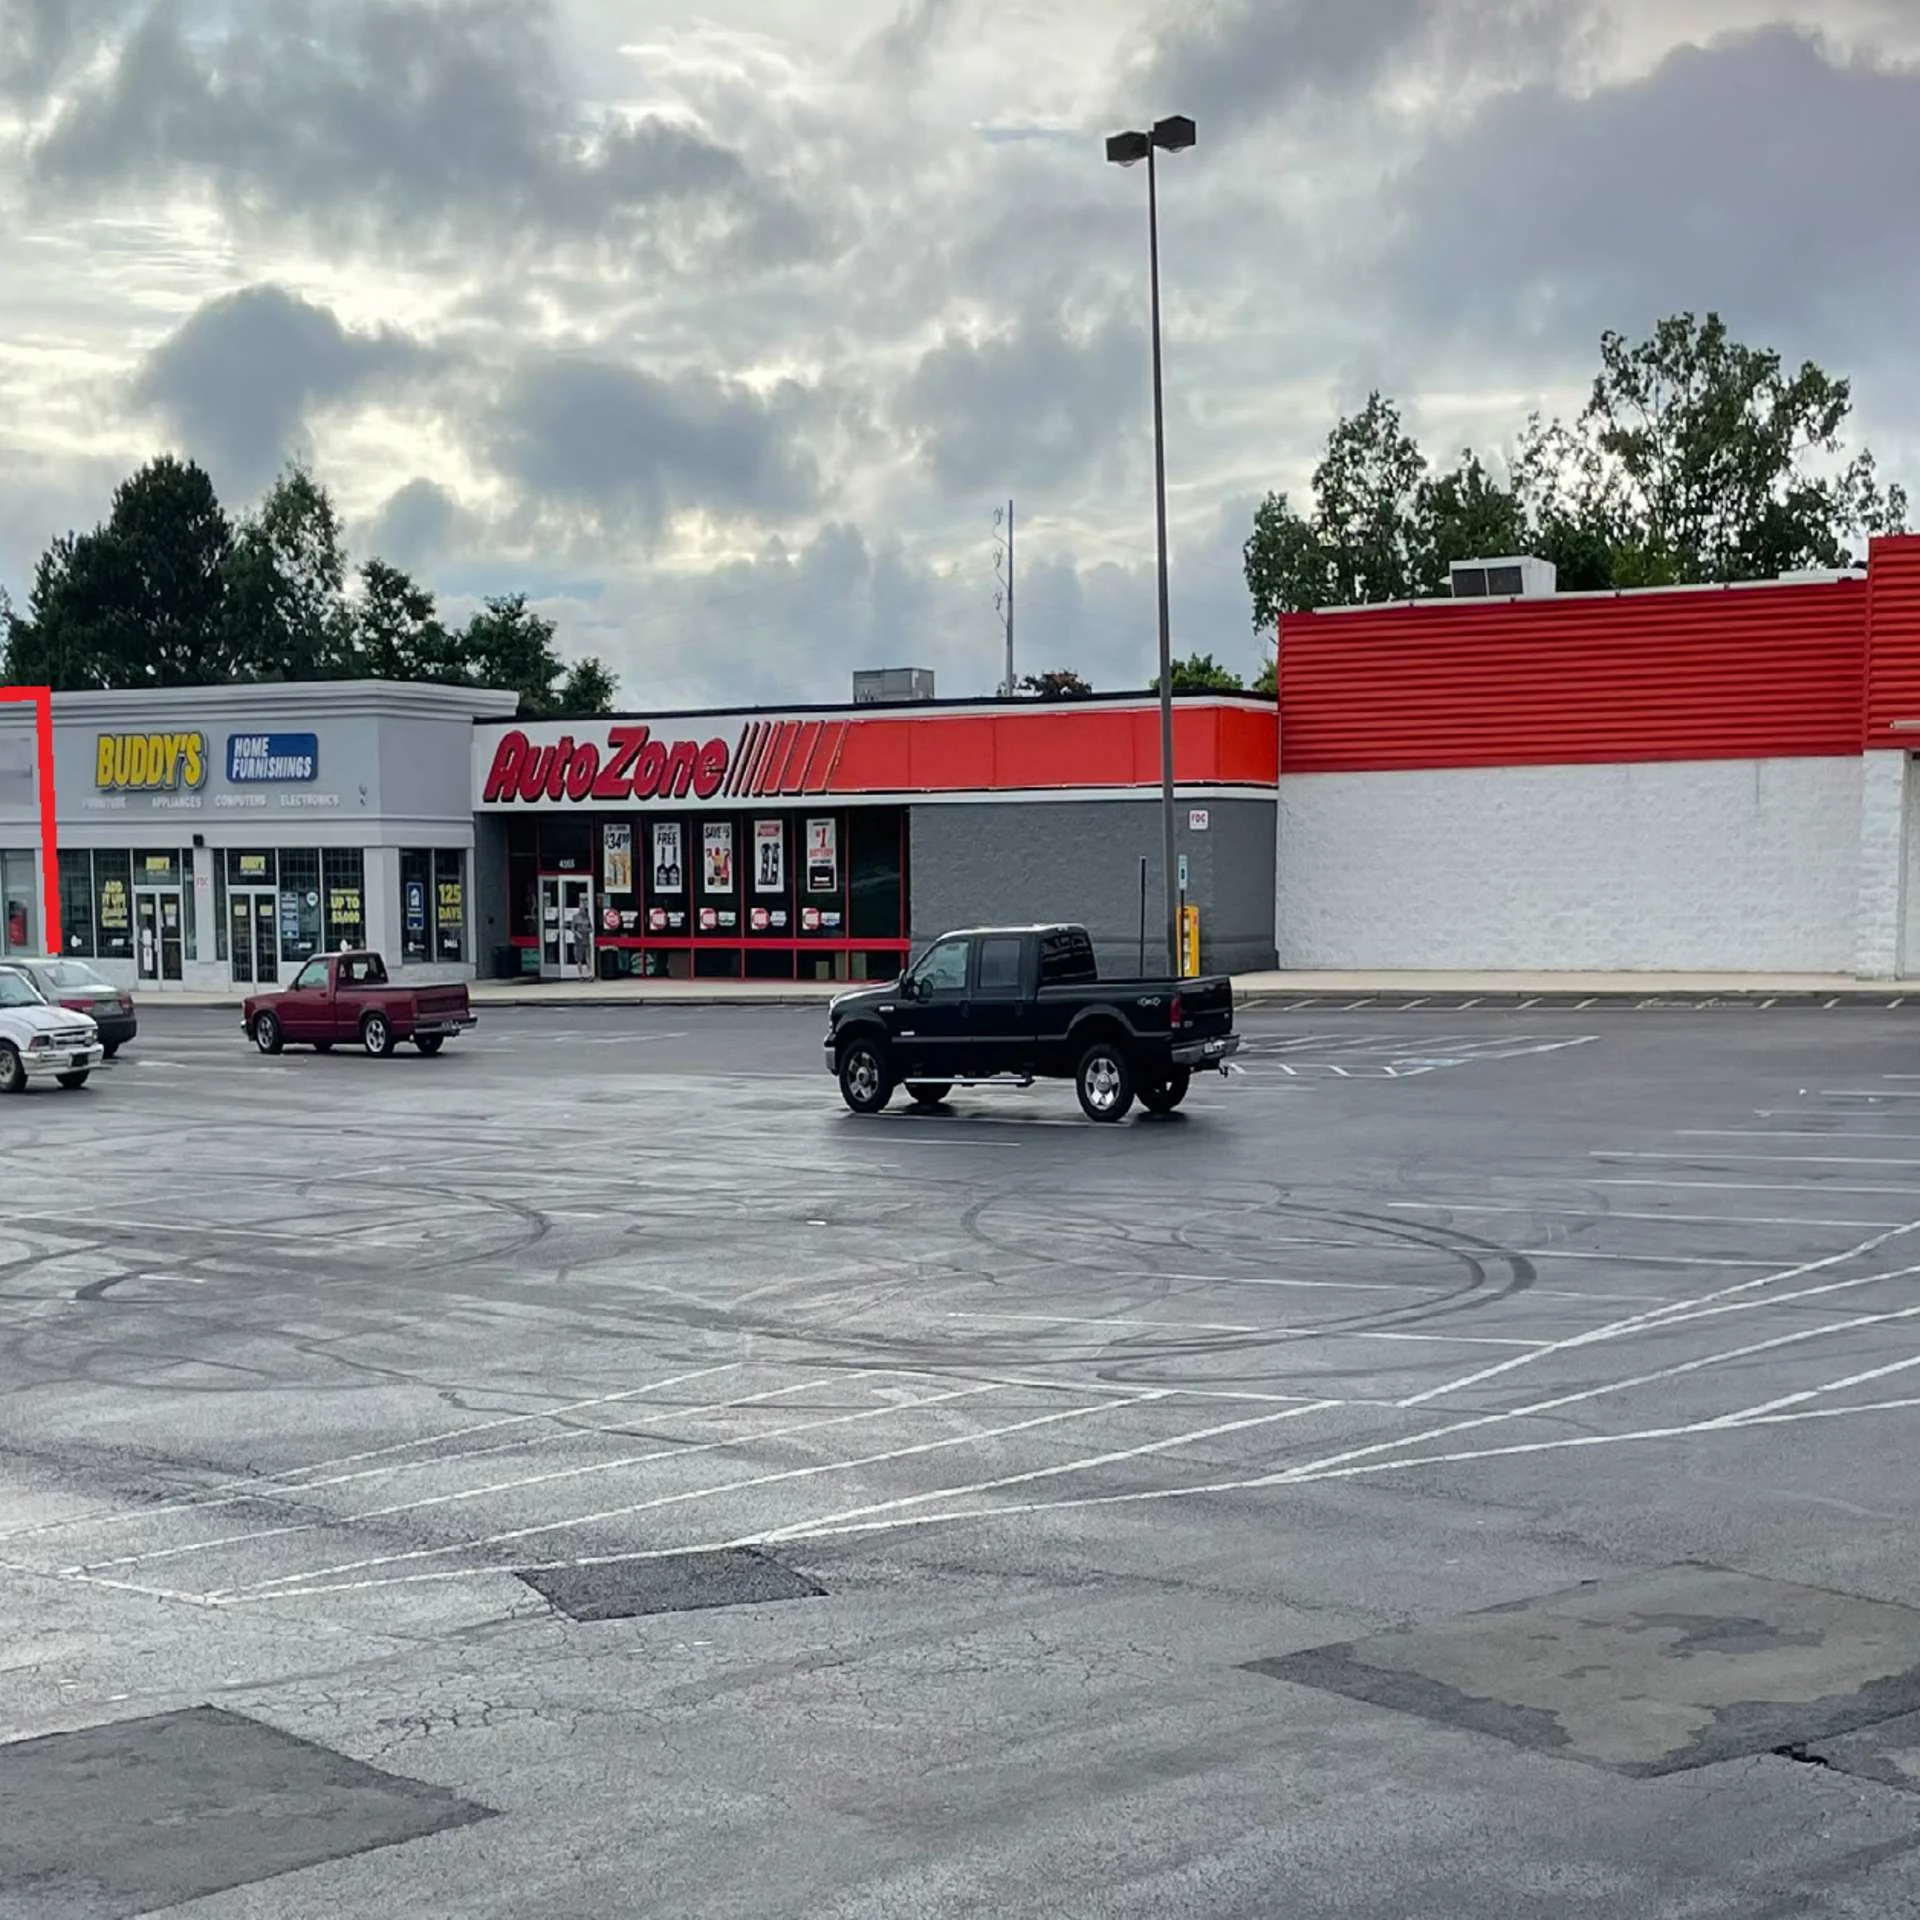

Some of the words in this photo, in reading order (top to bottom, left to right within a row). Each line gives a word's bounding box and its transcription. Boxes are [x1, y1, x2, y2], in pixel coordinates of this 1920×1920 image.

[234, 737, 269, 757] HOME
[96, 732, 206, 791] BUDDY'S
[232, 756, 312, 779] FURNISHINGS
[484, 727, 728, 802] AutoZone
[151, 795, 202, 808] APPLIANCES
[215, 794, 267, 807] COMPUTERS
[279, 794, 340, 807] ELECTRONICS
[658, 832, 678, 845] FREE
[438, 884, 462, 904] 125
[331, 896, 344, 909] UP
[347, 895, 360, 909] TO
[438, 906, 463, 920] DAYS
